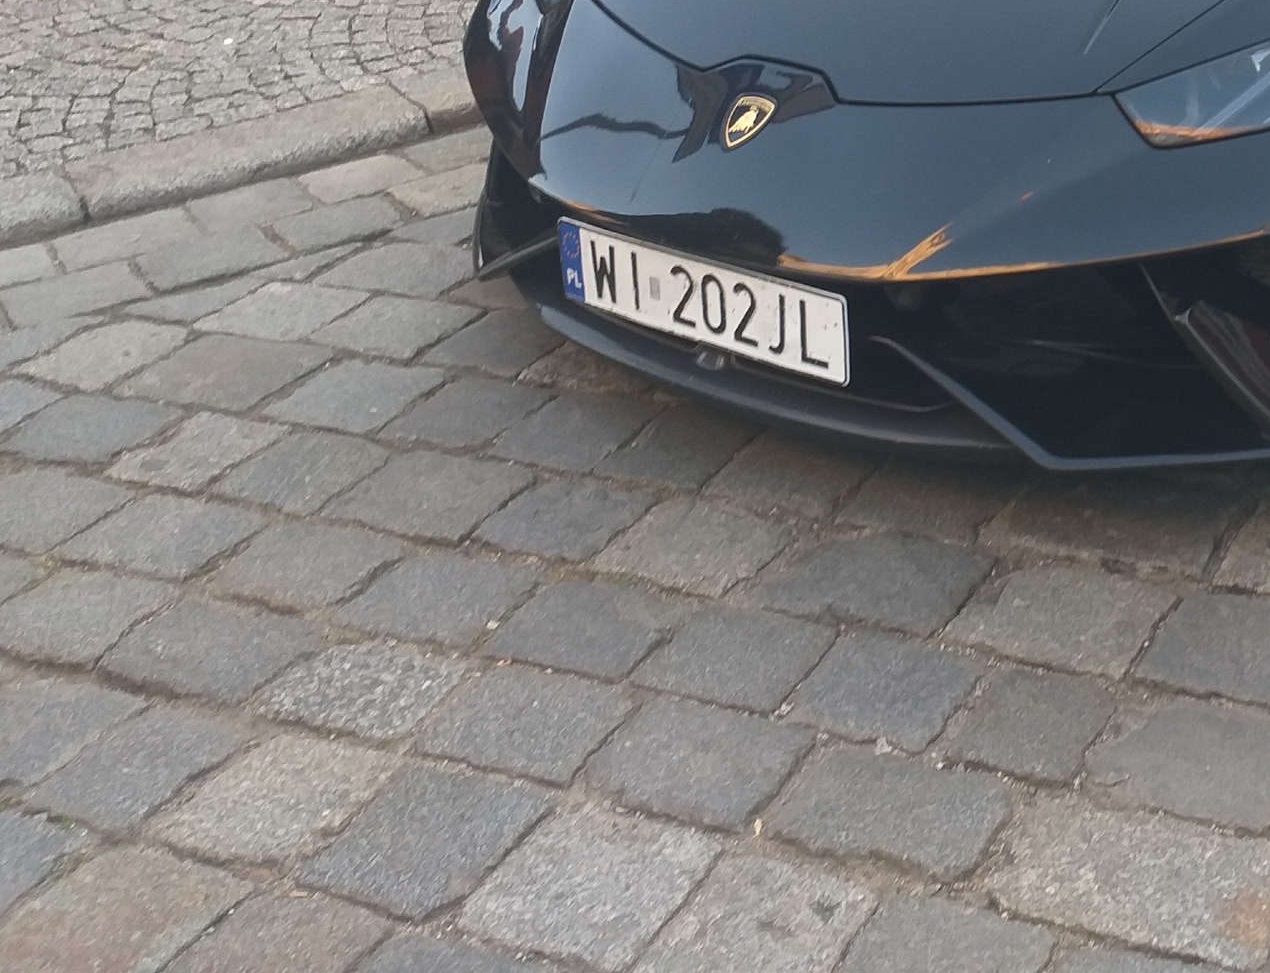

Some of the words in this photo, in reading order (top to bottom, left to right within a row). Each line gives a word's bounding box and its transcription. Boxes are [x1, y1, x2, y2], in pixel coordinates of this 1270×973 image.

[566, 267, 583, 288] PL
[590, 240, 640, 311] WI
[669, 264, 829, 369] 202JL
